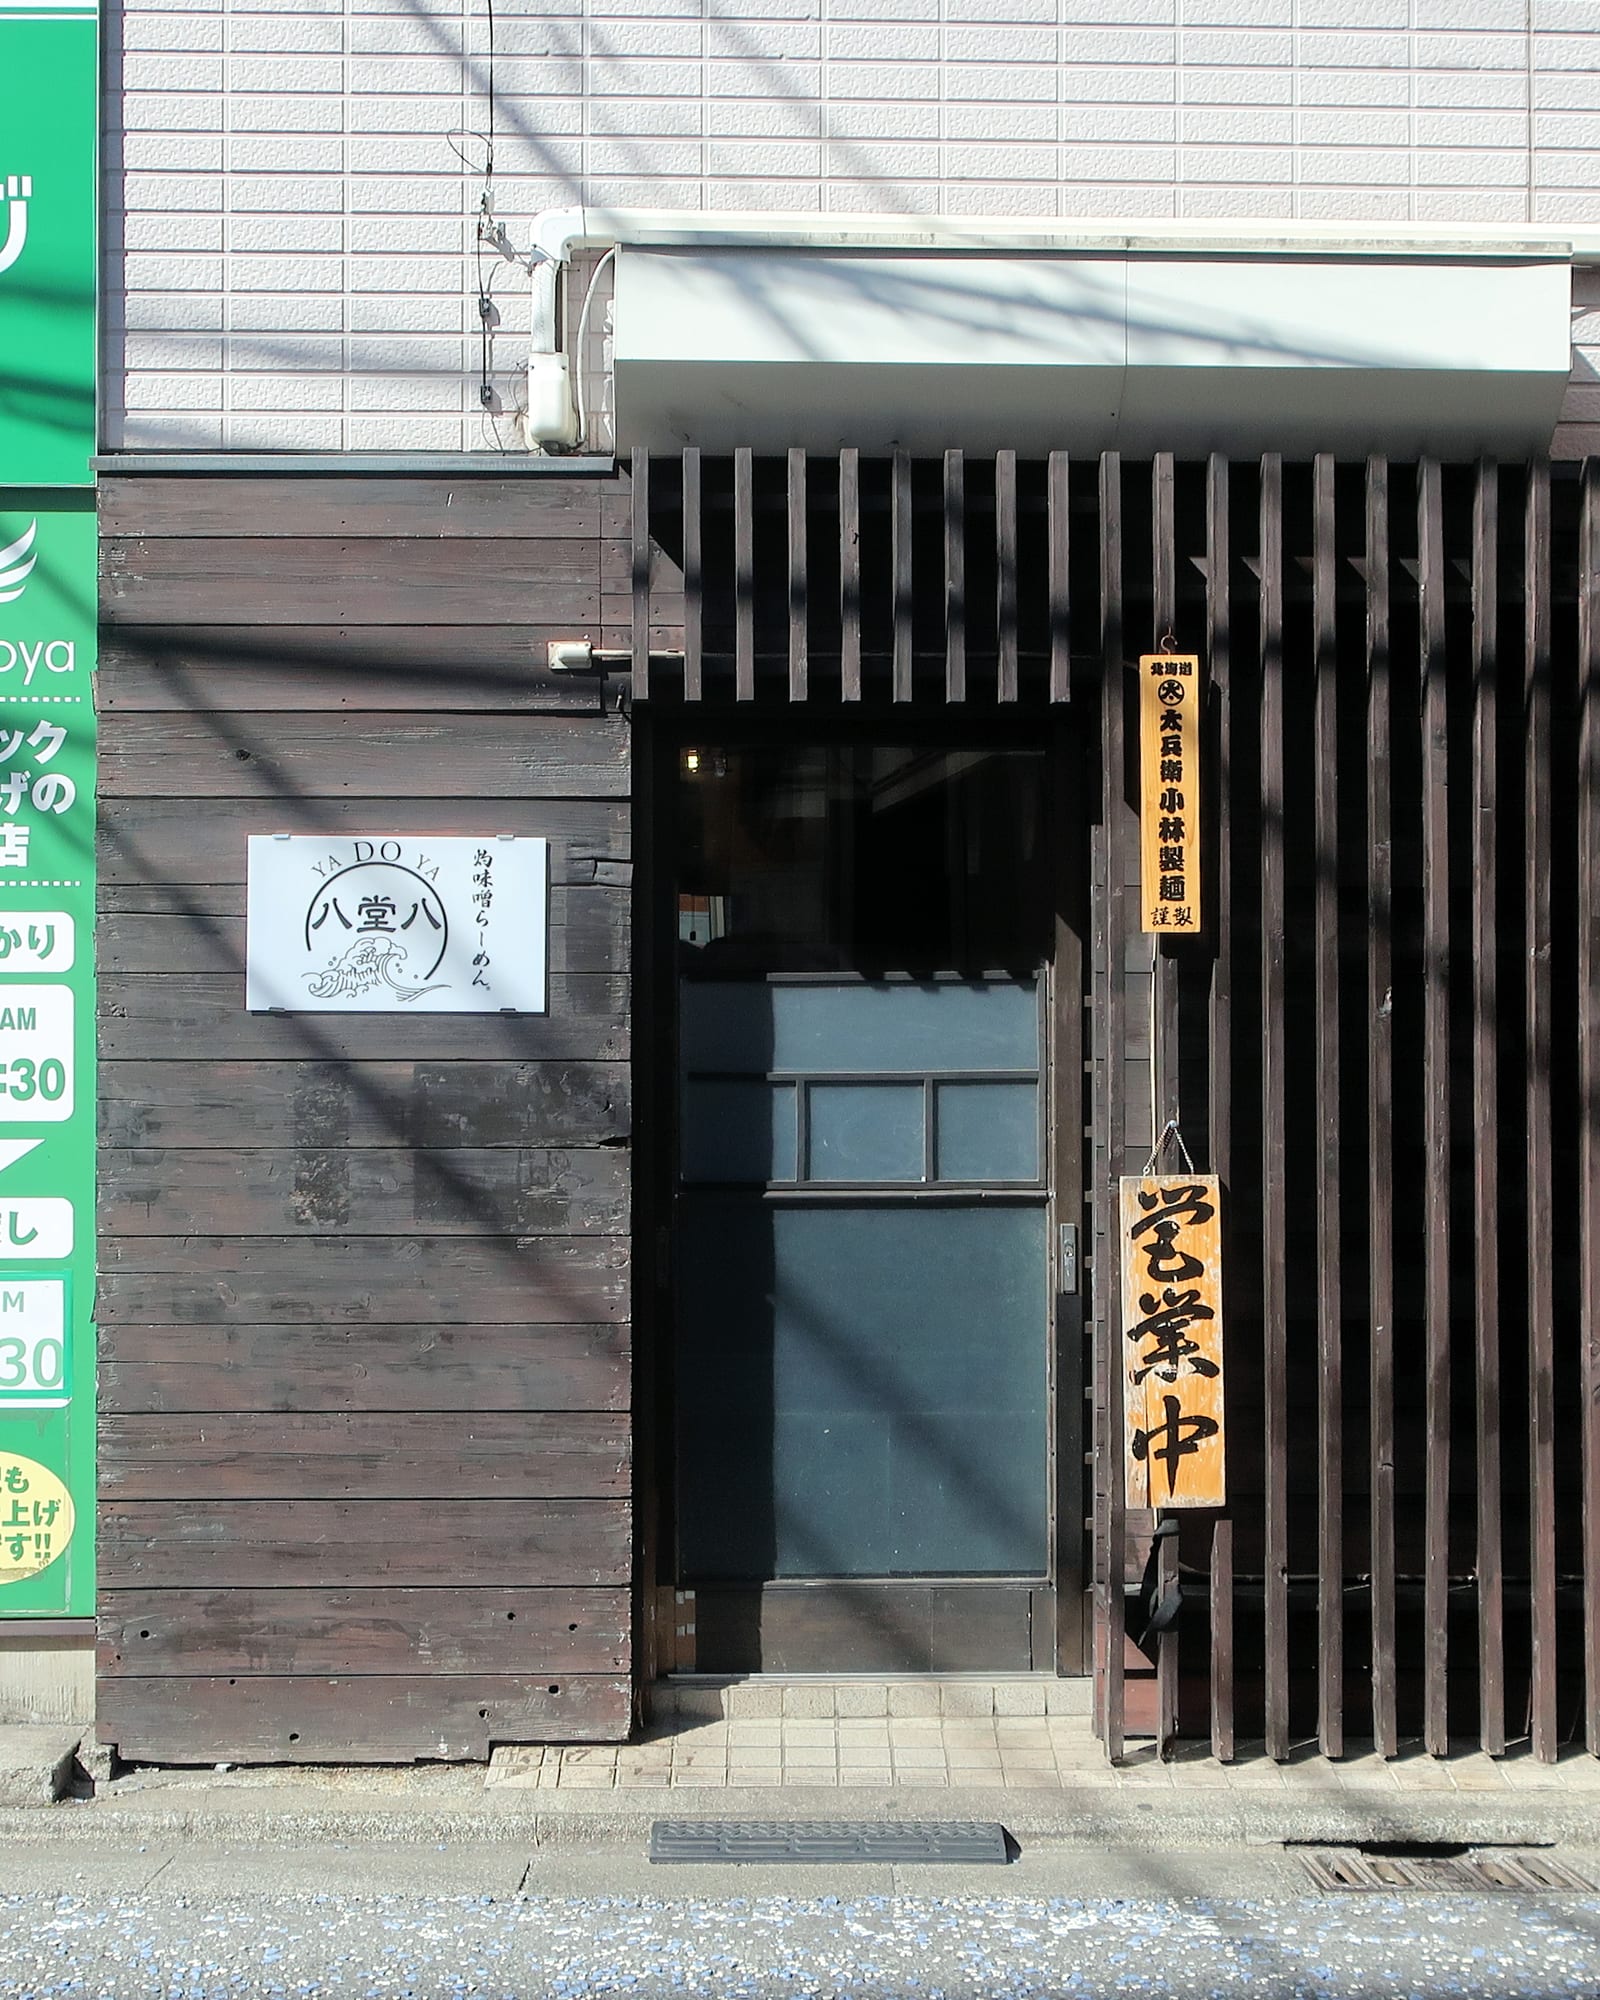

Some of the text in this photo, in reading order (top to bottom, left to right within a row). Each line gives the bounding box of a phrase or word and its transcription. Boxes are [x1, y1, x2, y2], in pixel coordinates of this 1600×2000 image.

[1150, 661, 1193, 676] 北海道
[311, 895, 442, 933] 八堂八
[1150, 906, 1194, 927] 謹製
[0, 1007, 37, 1031] AM
[0, 1210, 39, 1246] し
[1127, 1184, 1220, 1499] 営業中
[0, 1466, 30, 1494] も
[1, 1498, 61, 1527] 上げ
[0, 1533, 51, 1562] す!!
